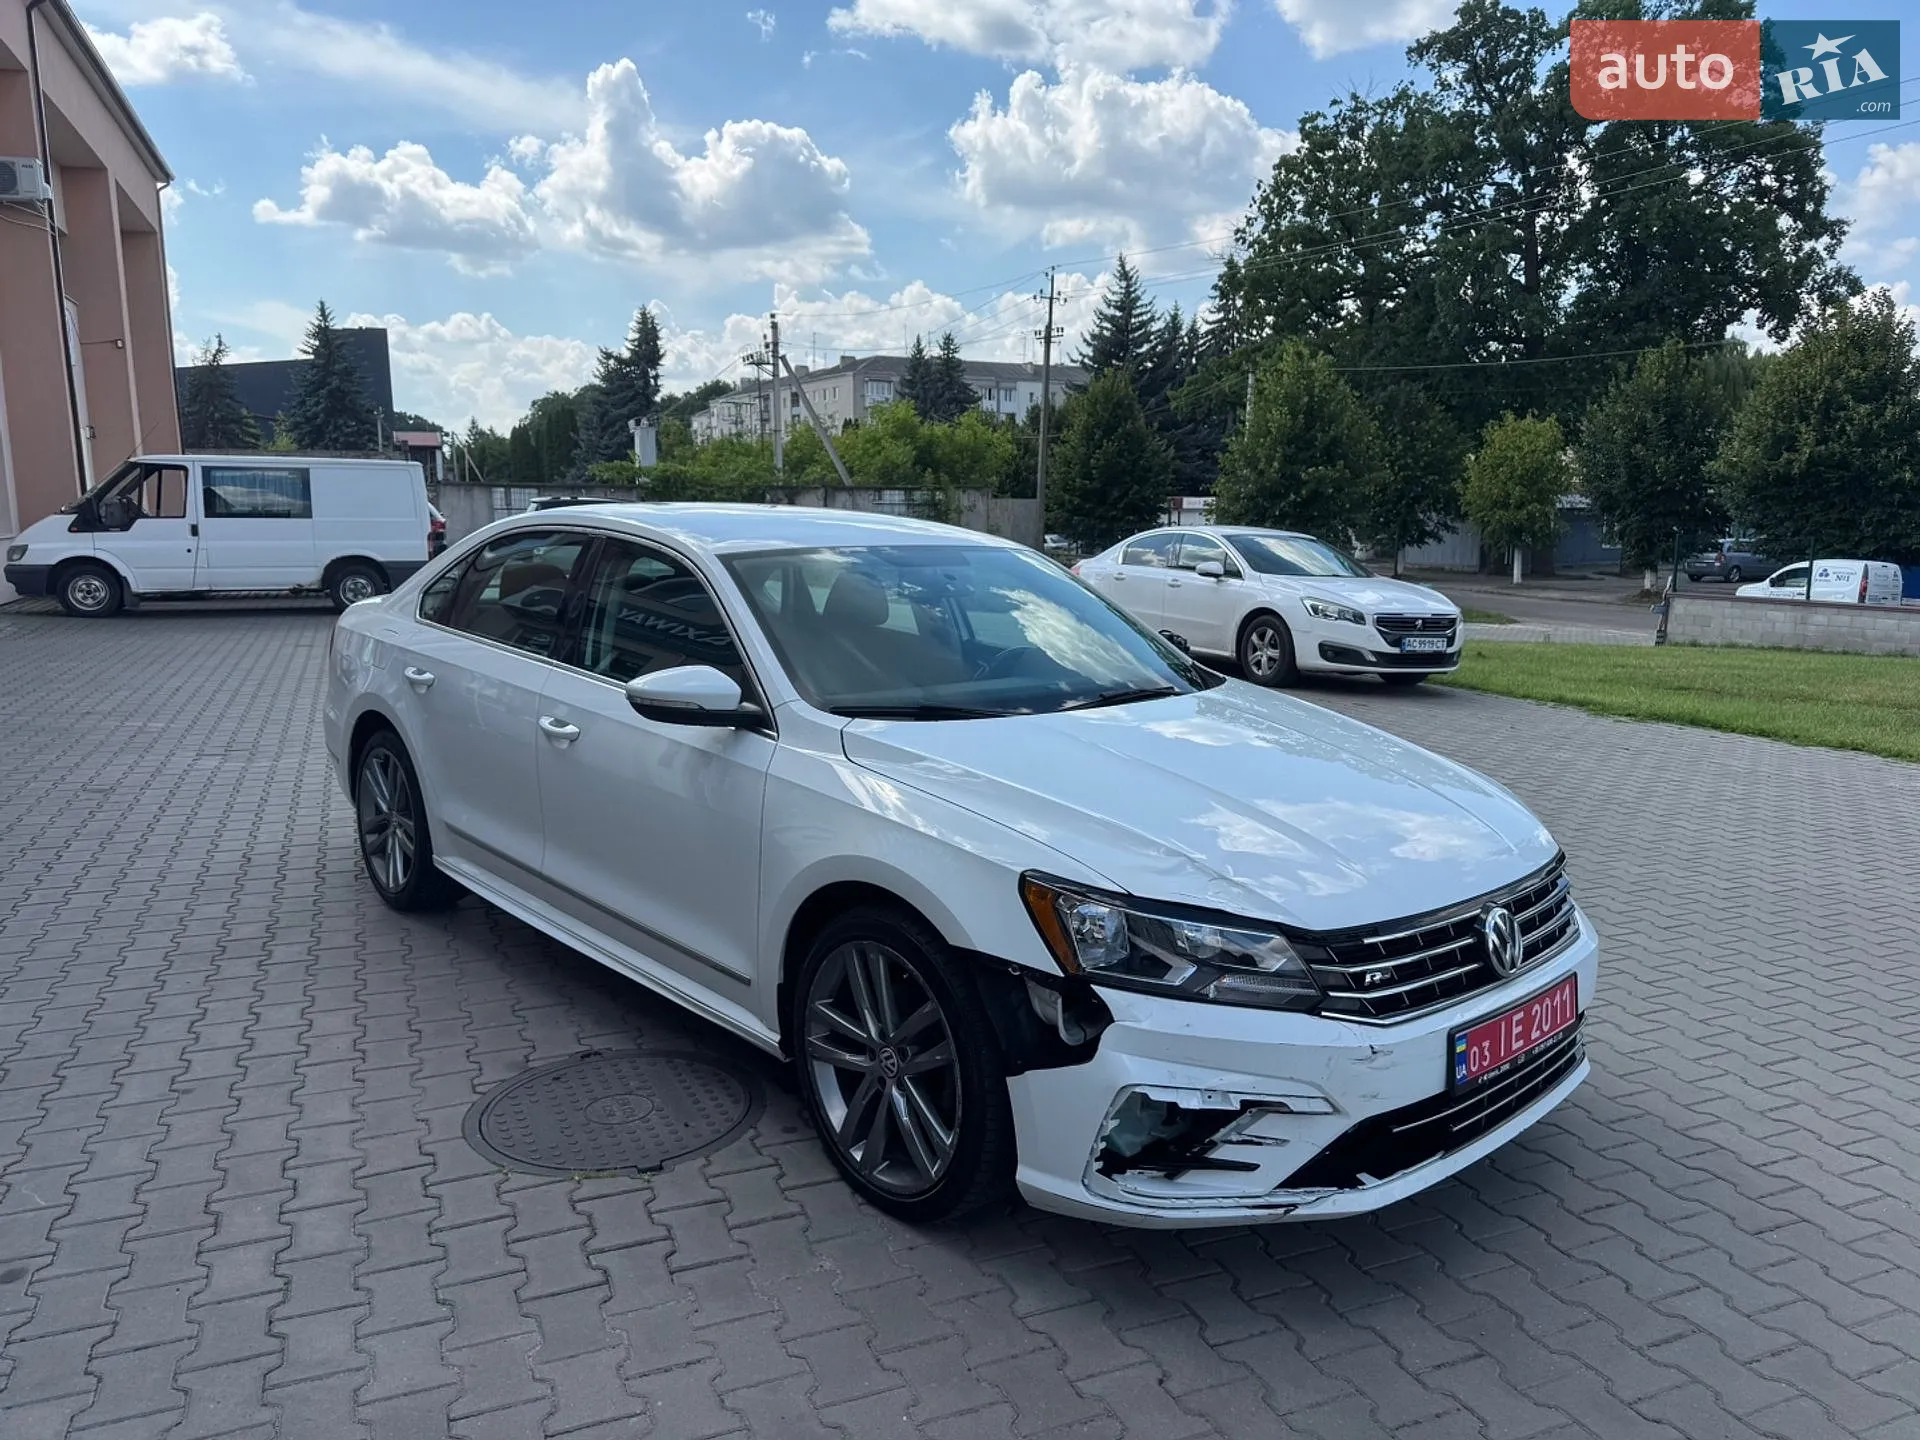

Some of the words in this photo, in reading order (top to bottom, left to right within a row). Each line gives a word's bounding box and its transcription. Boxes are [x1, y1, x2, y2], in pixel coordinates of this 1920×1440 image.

[1456, 1065, 1467, 1079] UA
[1470, 1040, 1490, 1072] 03
[1500, 1011, 1525, 1057] IE
[1531, 984, 1571, 1040] 2011
